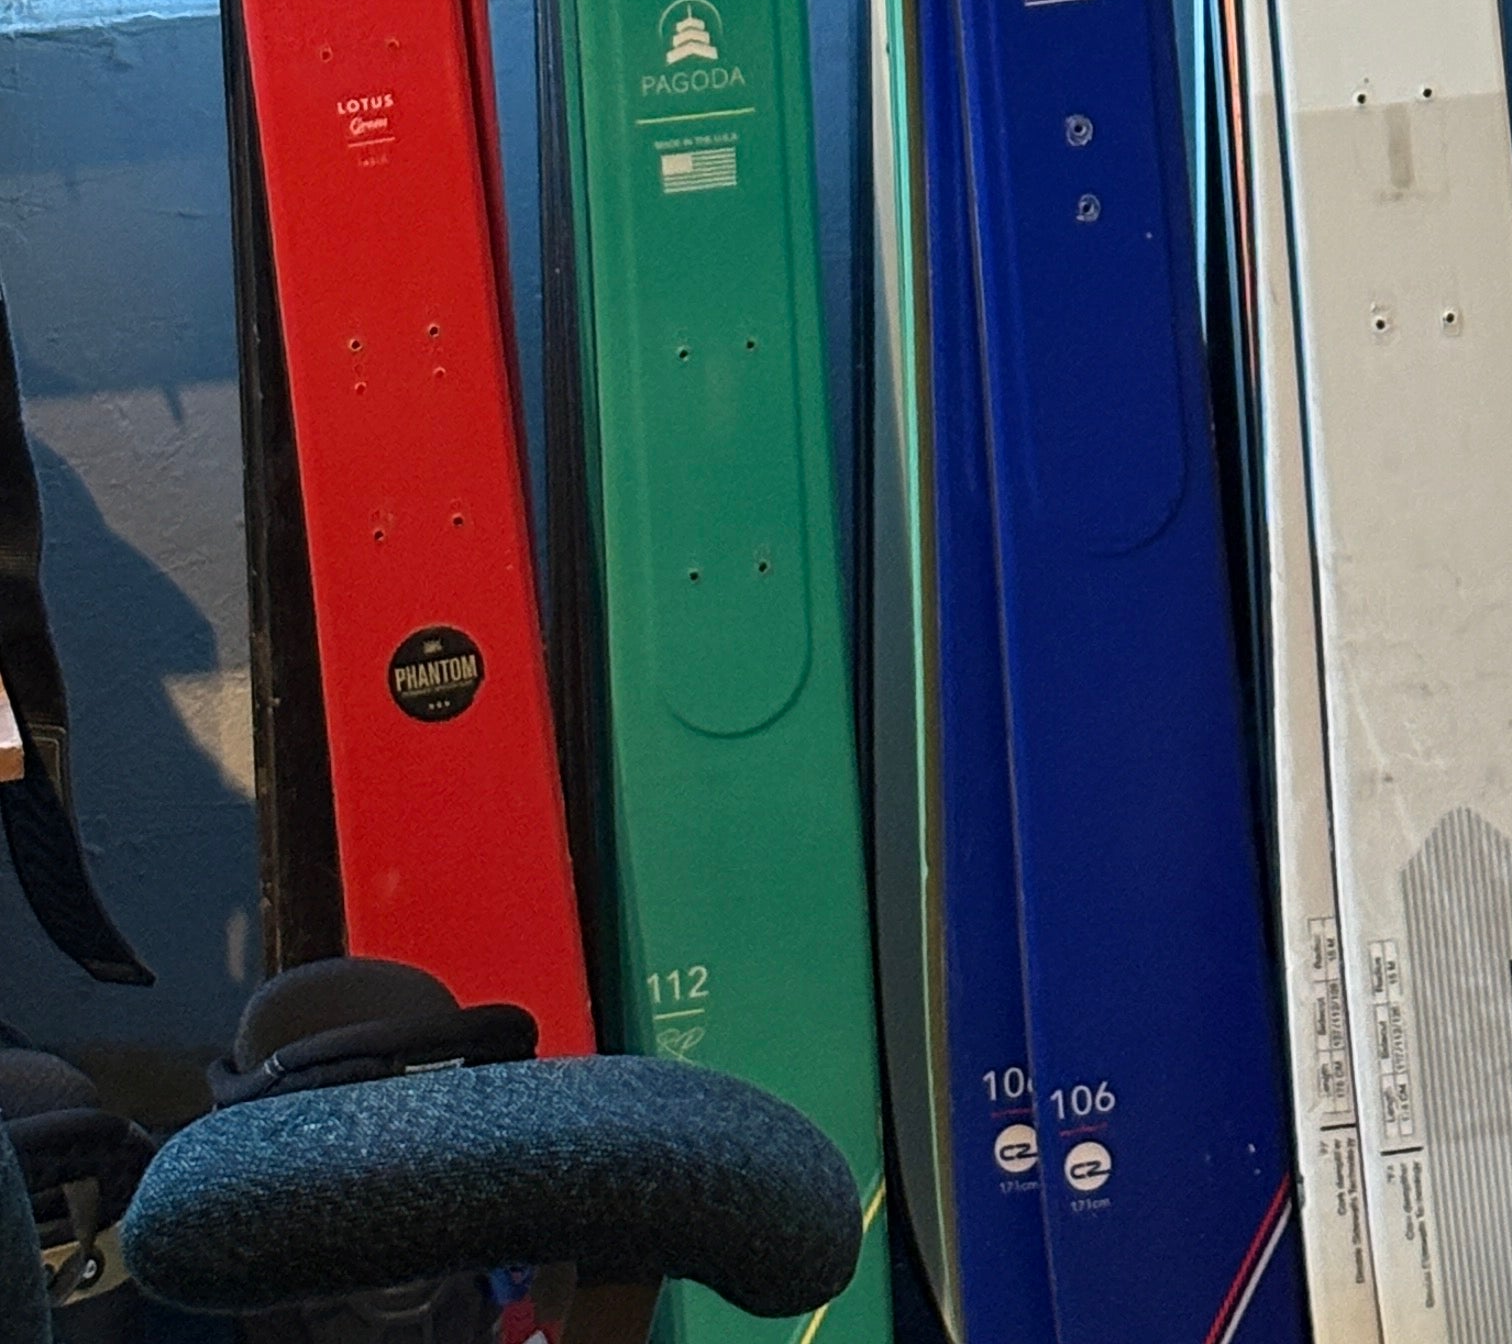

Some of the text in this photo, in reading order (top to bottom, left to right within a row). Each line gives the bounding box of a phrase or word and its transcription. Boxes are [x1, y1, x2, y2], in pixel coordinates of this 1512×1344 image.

[641, 66, 746, 97] PAGODA
[337, 94, 394, 114] LOTUS
[394, 654, 478, 692] PHANTOM
[647, 965, 709, 1003] 112
[982, 1067, 1033, 1101] 10
[1050, 1080, 1116, 1119] 106
